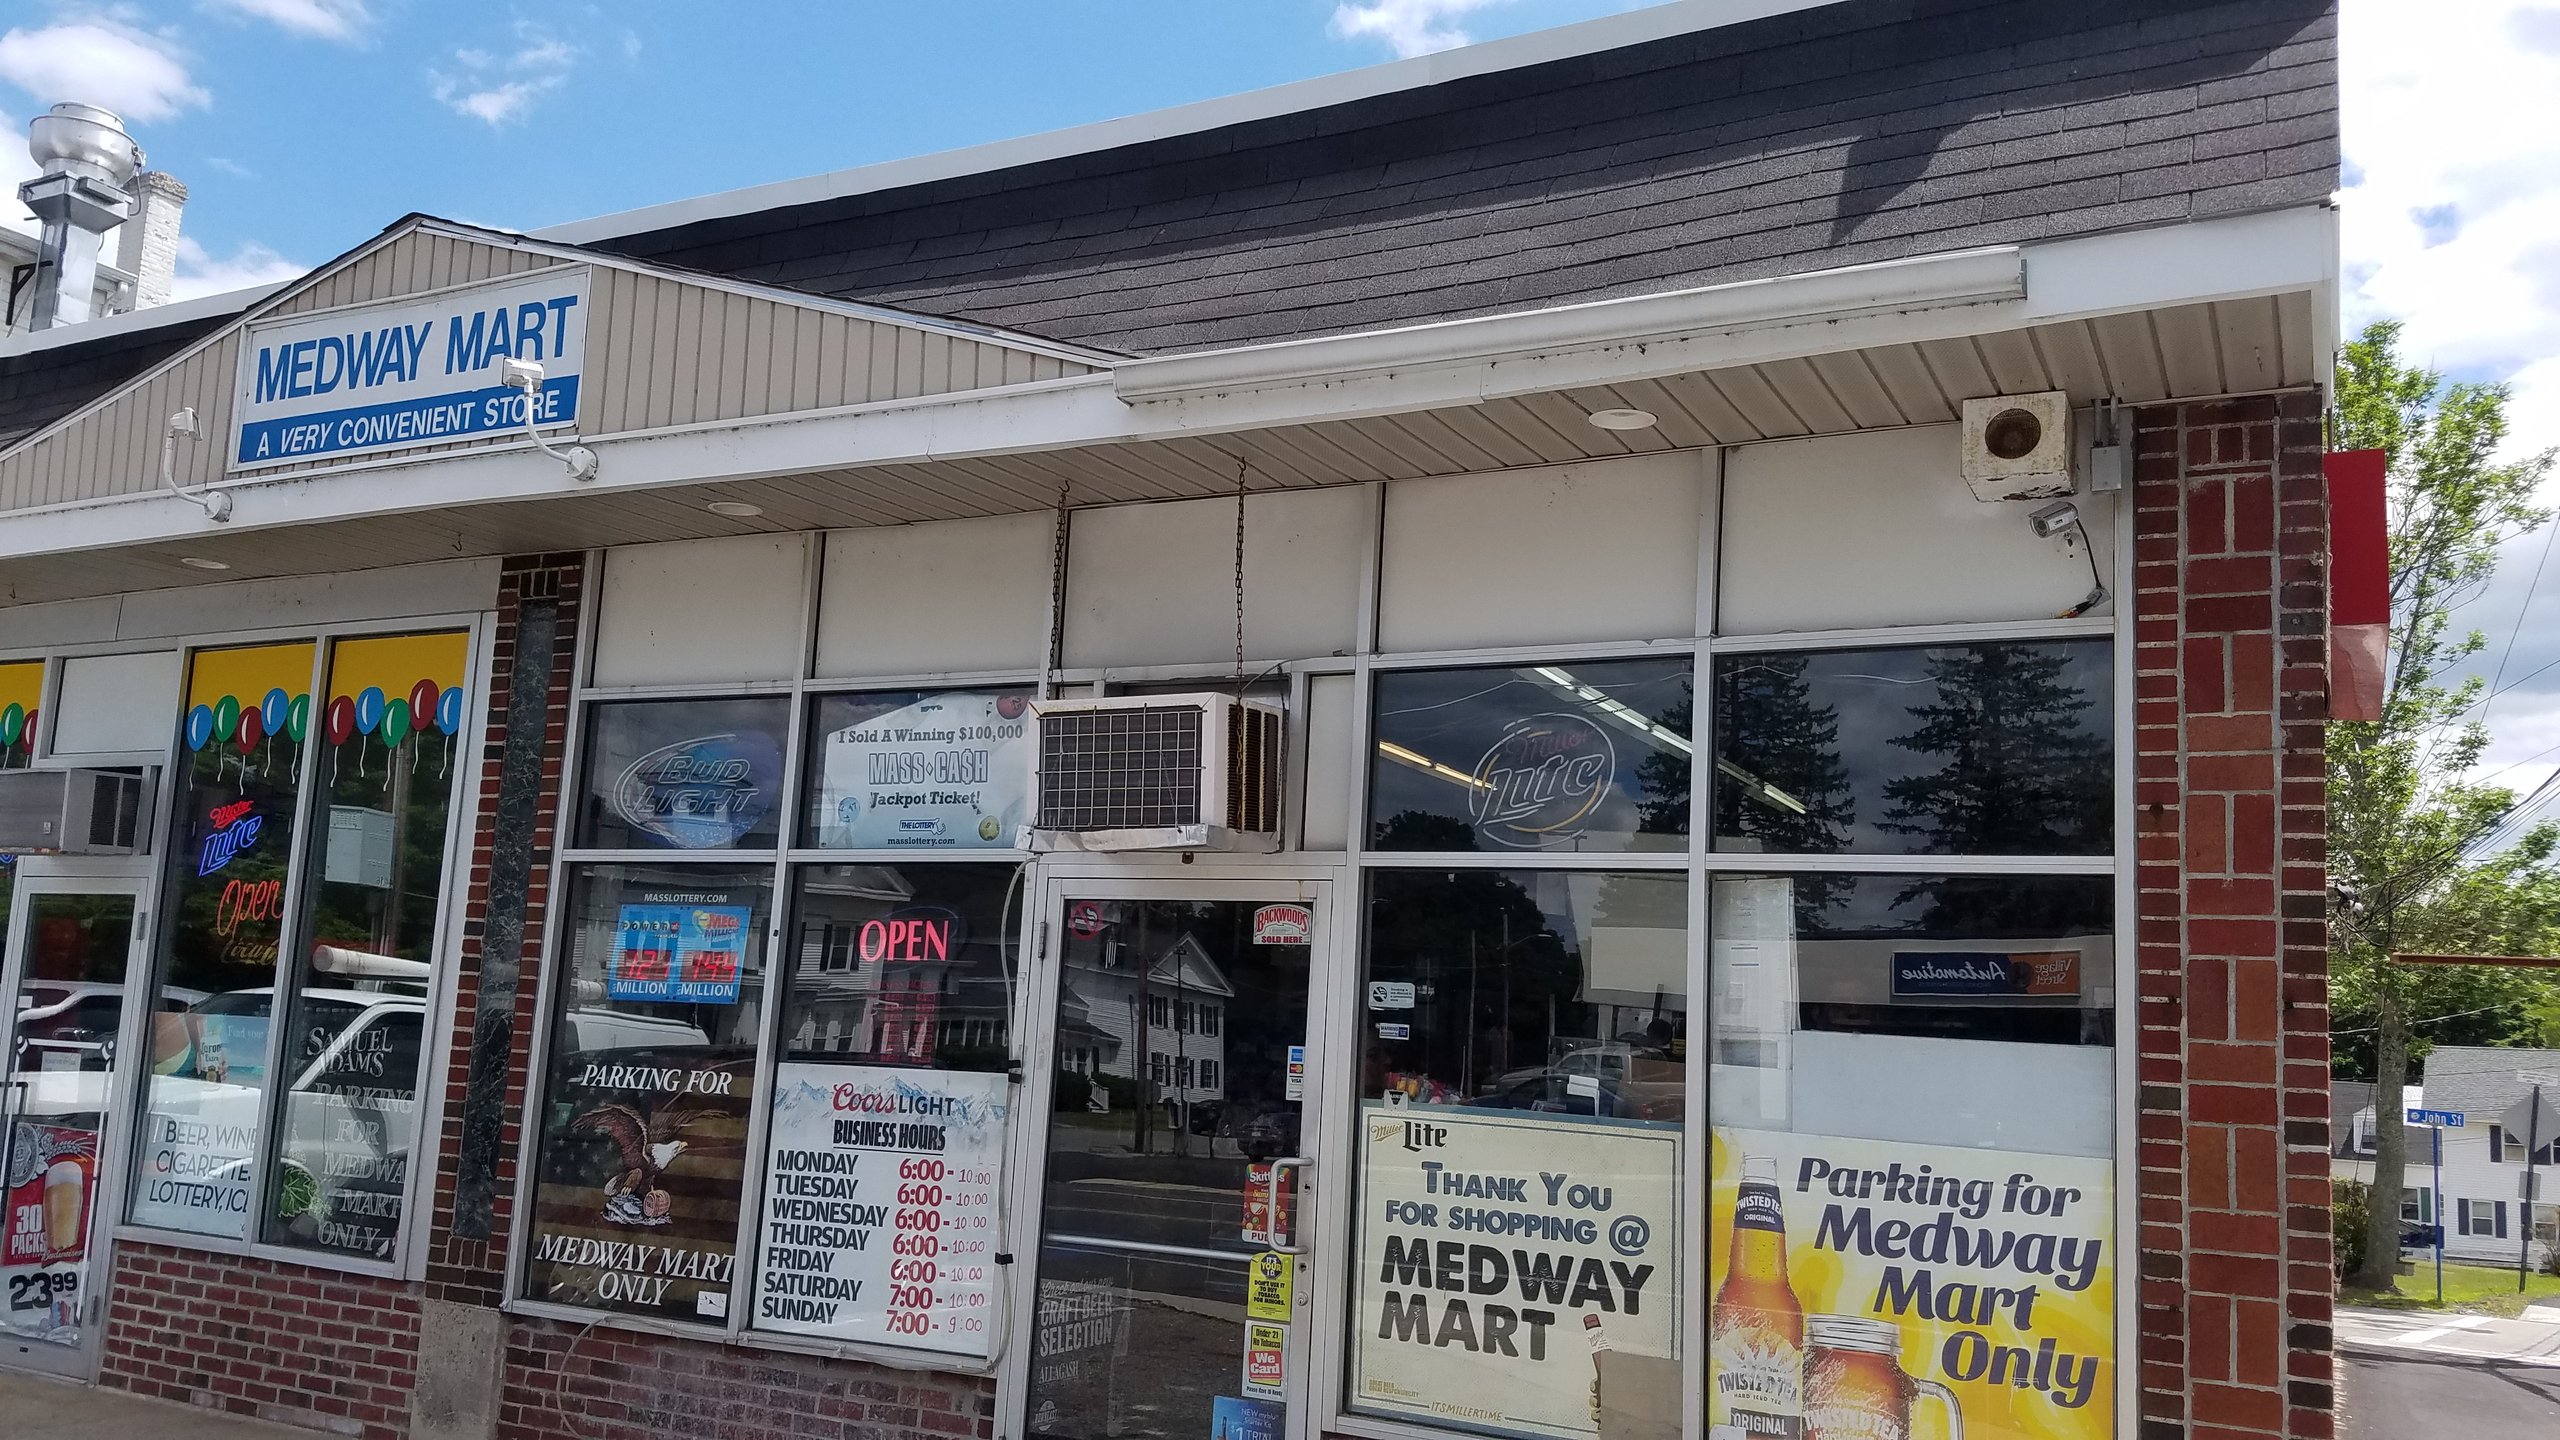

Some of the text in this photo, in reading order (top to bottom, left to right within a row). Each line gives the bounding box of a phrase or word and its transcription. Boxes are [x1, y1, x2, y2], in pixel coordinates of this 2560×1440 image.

[255, 295, 579, 404] MEDWAY MART
[256, 390, 560, 458] A VERY CONVENIENT STORE
[839, 725, 1023, 744] I Sold A Winning $100,000
[869, 752, 925, 784] MASS
[633, 786, 759, 813] LIGHT
[871, 791, 980, 809] Jackpot Ticket!
[1475, 754, 1605, 826] Lite
[199, 816, 262, 876] Lite
[887, 836, 955, 846] masslottery.com
[217, 879, 284, 944] Open
[644, 893, 728, 903] MASSLOTTERY.COM
[1256, 907, 1309, 933] BACKWOODS
[859, 919, 949, 961] OPEN
[1283, 936, 1303, 944] HERE
[616, 982, 667, 995] MILLION
[680, 983, 733, 997] MILLION
[306, 1027, 394, 1056] SAMUEL
[580, 1064, 733, 1096] PARKING FOR
[312, 1082, 415, 1113] PARKING
[832, 1082, 955, 1116] Coors LIGHT
[165, 1120, 210, 1148] BEER,
[335, 1118, 381, 1145] FOR
[2421, 1112, 2462, 1126] John St
[833, 1119, 946, 1151] BUSINESS HOURS
[1371, 1121, 1449, 1152] Miller Lite
[156, 1150, 251, 1181] CIGARETTE
[776, 1150, 859, 1175] MONDAY
[149, 1179, 223, 1214] LOTTERY,
[775, 1173, 859, 1200] TUESDAY
[1421, 1161, 1612, 1212] THANK YOU
[1796, 1157, 2081, 1219] Parking for
[772, 1197, 889, 1228] WEDNESDAY
[1736, 1195, 1771, 1212] TWISTED
[1744, 1213, 1776, 1224] ORIGINAL
[16, 1204, 43, 1234] 30
[1385, 1200, 1651, 1257] FOR SHOPPING @
[11, 1233, 47, 1255] PACKS
[317, 1221, 382, 1252] ONLY
[770, 1222, 870, 1251] THURSDAY
[1814, 1204, 2102, 1292] Medway
[535, 1233, 736, 1283] MEDWAY MART
[766, 1247, 835, 1273] FRIDAY
[1261, 1263, 1281, 1271] YOUR
[598, 1271, 673, 1306] ONLY
[763, 1271, 863, 1302] SATURDAY
[1380, 1235, 1655, 1316] MEDWAY
[761, 1296, 838, 1325] SUNDAY
[1040, 1291, 1113, 1327] CRAFT BEER
[1873, 1266, 2040, 1331] Mart
[1039, 1317, 1113, 1358] SELECTION
[1272, 1330, 1279, 1339] 21
[1378, 1291, 1556, 1362] MART
[1038, 1360, 1079, 1384] ALLAGASH
[1250, 1363, 1280, 1375] Card
[1255, 1352, 1276, 1364] We
[1941, 1330, 2099, 1409] Only
[1241, 1408, 1259, 1417] NEW
[1431, 1401, 1502, 1421] ITSMILLERTIME
[1734, 1412, 1788, 1436] ORIGINAL
